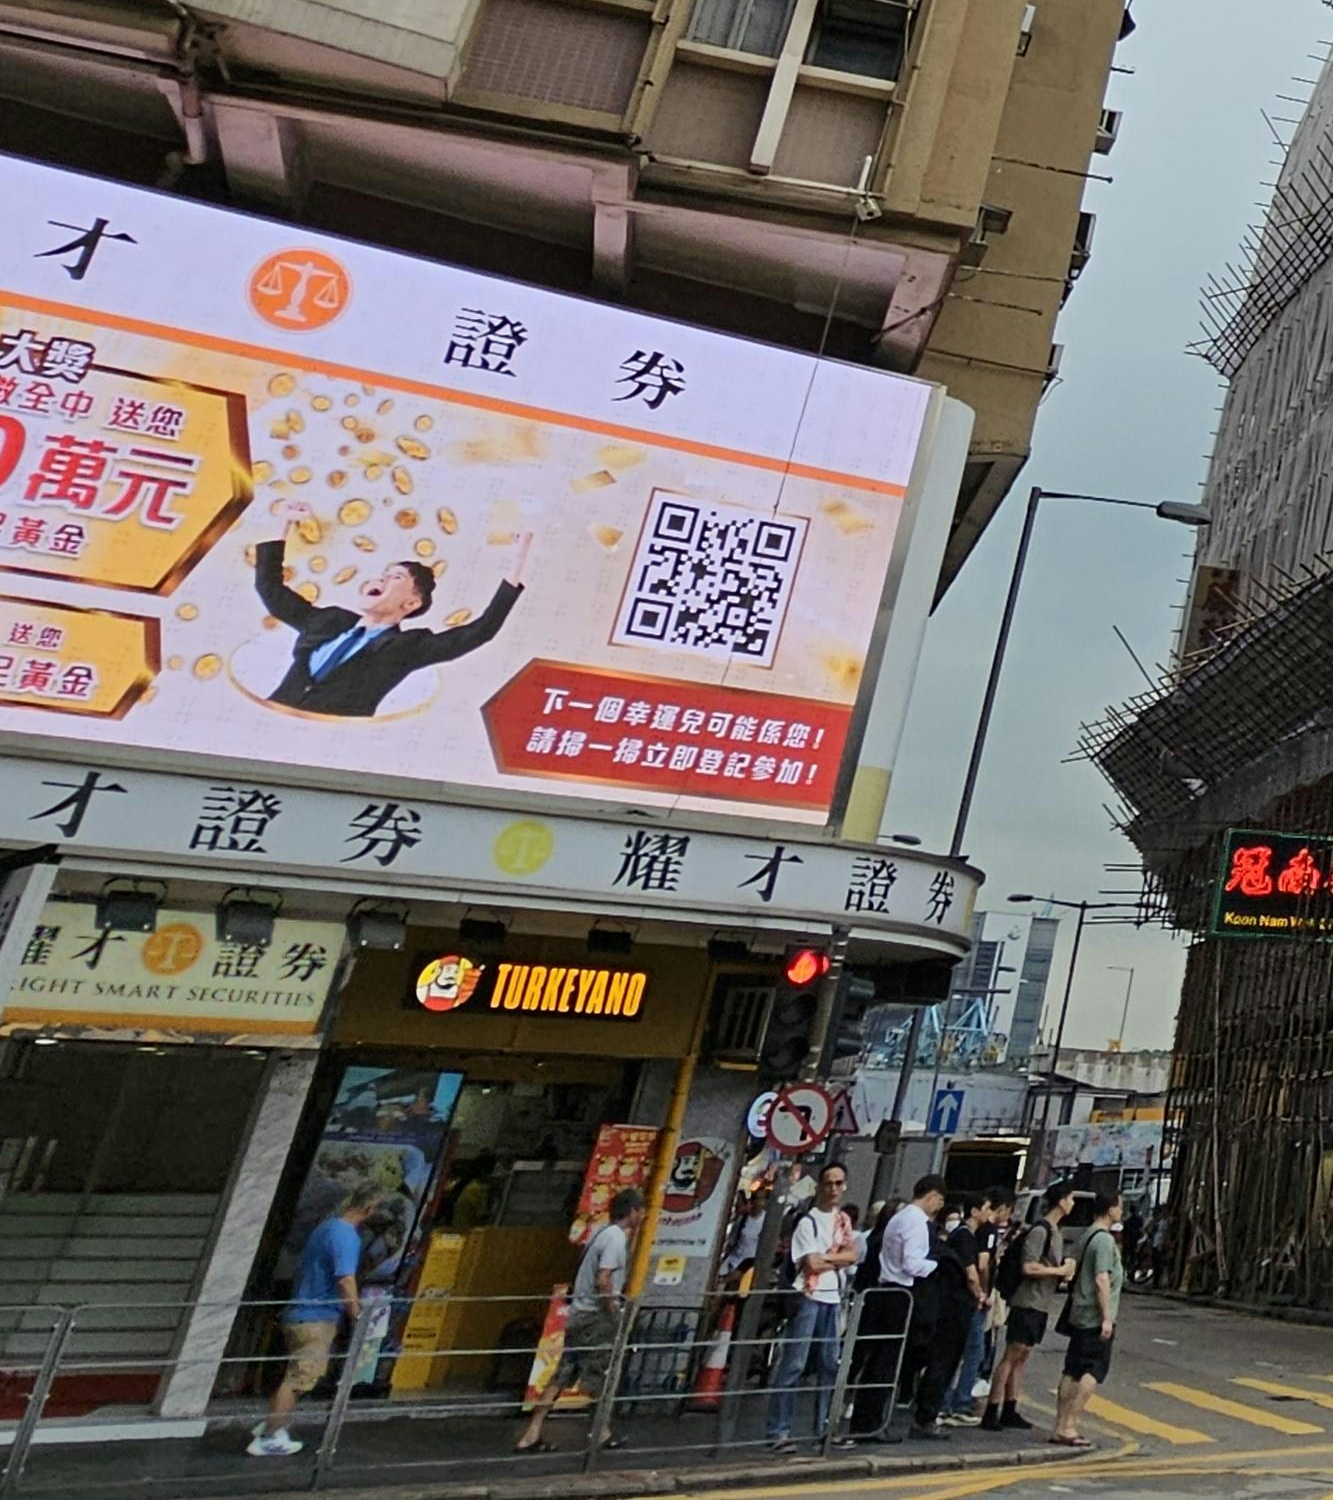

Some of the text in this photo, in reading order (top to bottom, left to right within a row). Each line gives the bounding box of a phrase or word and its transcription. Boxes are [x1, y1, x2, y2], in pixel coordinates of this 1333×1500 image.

[34, 216, 687, 411] 才 證券
[108, 397, 183, 437] 送您
[0, 512, 84, 555] 黃金
[1259, 915, 1288, 928] Nam
[94, 981, 181, 1001] SMART
[185, 986, 316, 1008] SECURITIES
[489, 962, 648, 1018] TURKEYANO
